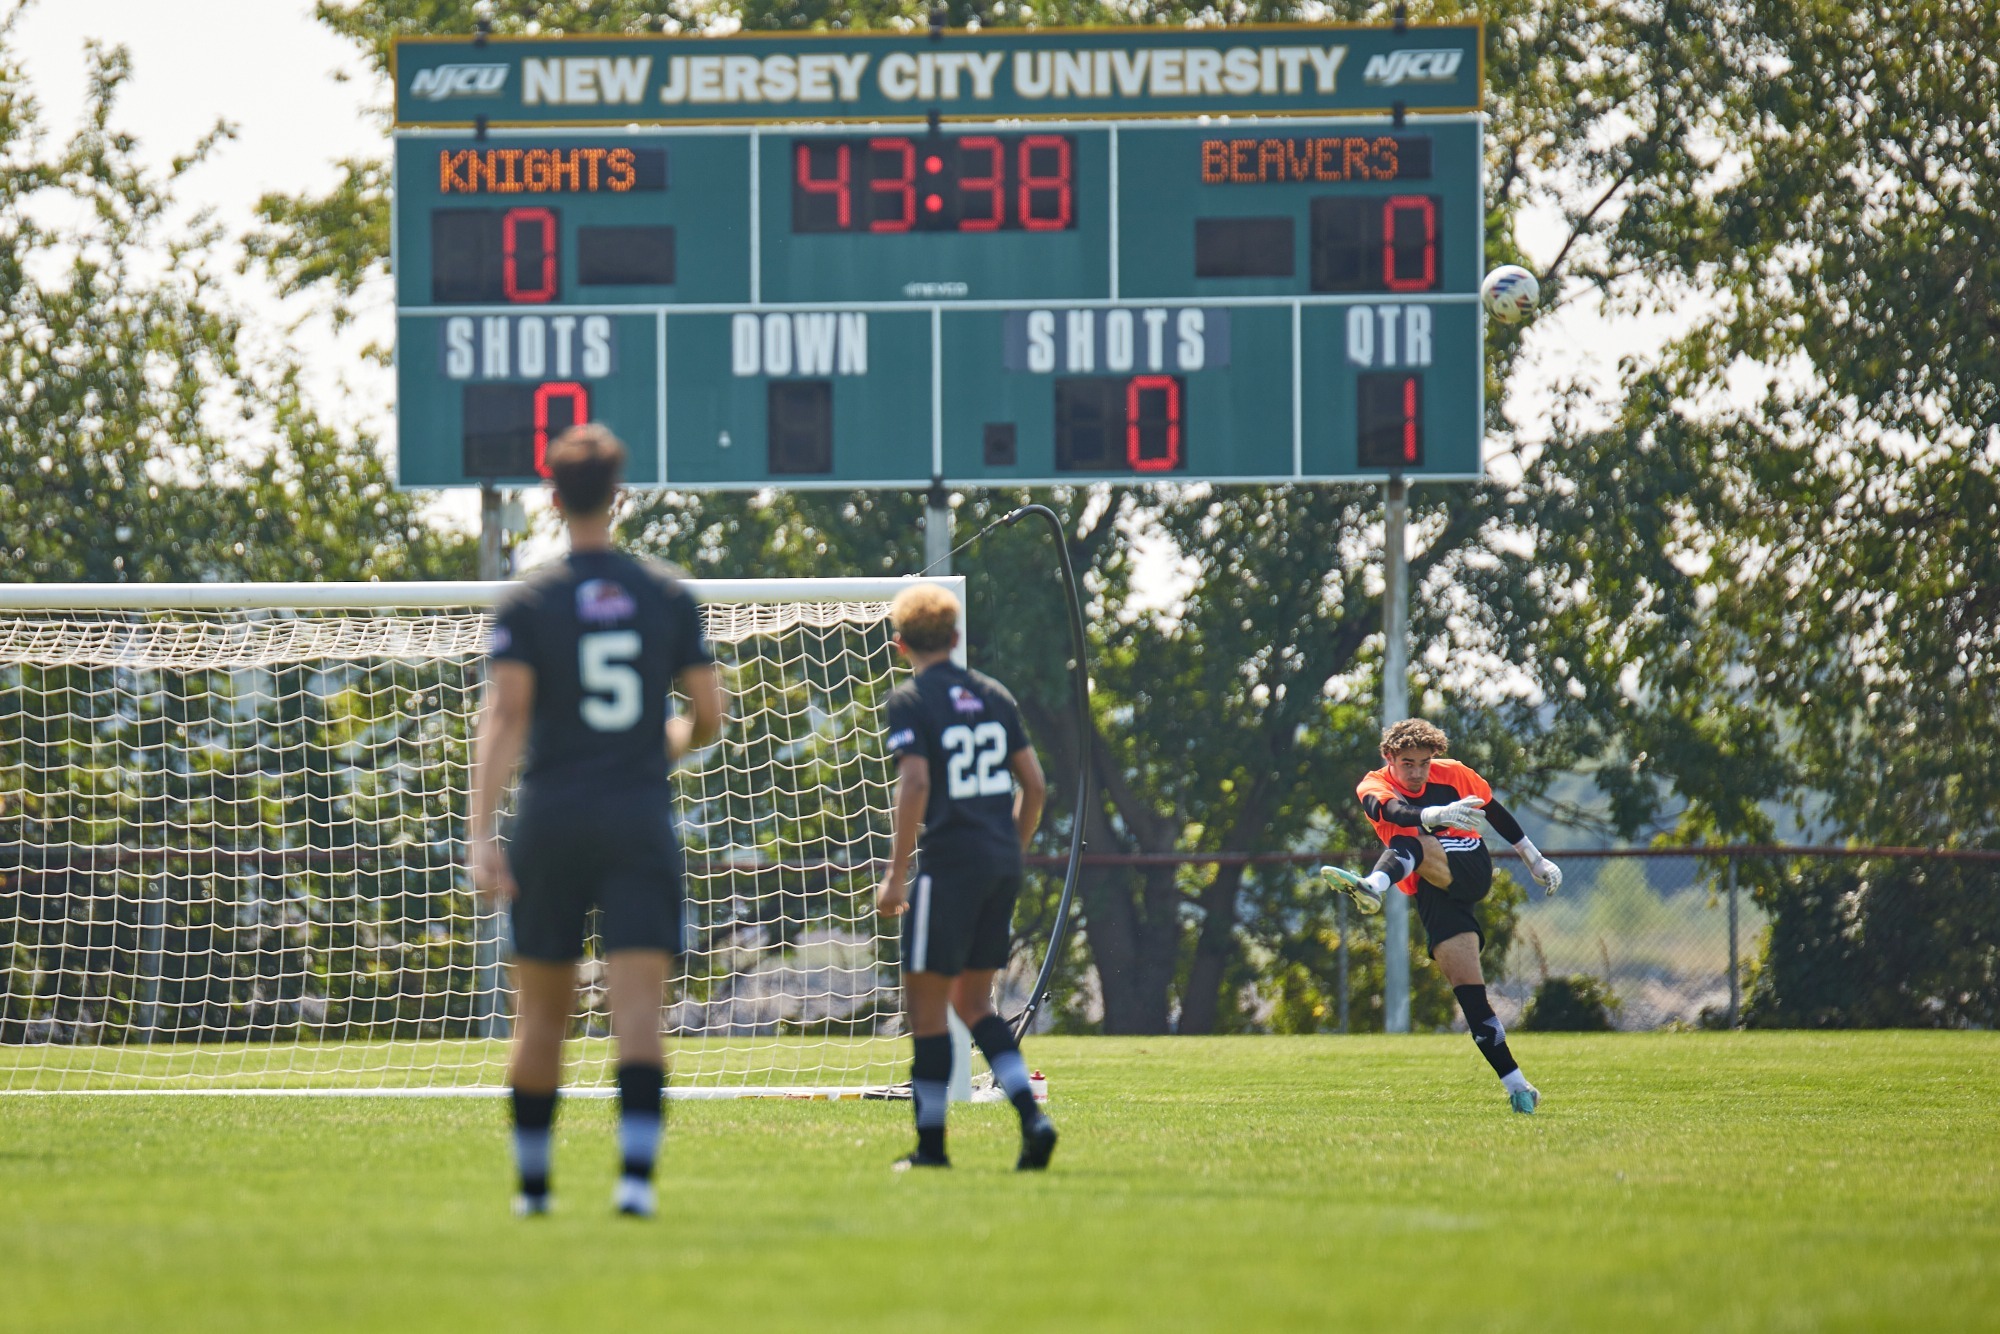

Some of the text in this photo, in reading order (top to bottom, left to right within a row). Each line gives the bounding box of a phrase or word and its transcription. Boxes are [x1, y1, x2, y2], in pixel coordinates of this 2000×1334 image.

[409, 45, 1464, 105] NJCU NEW JERSEY CITY UNIVERSITY NJCU
[439, 148, 636, 194] KNIGHTS
[796, 135, 1071, 234] 43:38
[1201, 136, 1399, 184] BEAVERS
[503, 207, 557, 302] 0
[1383, 195, 1435, 291] 0
[446, 315, 611, 379] SHOTS
[731, 312, 868, 377] DOWN
[1027, 307, 1205, 374] SHOTS
[1347, 304, 1432, 368] QTR
[1126, 375, 1180, 472] 0
[1403, 377, 1418, 464] 1
[578, 629, 643, 733] 5
[942, 721, 1013, 799] 22
